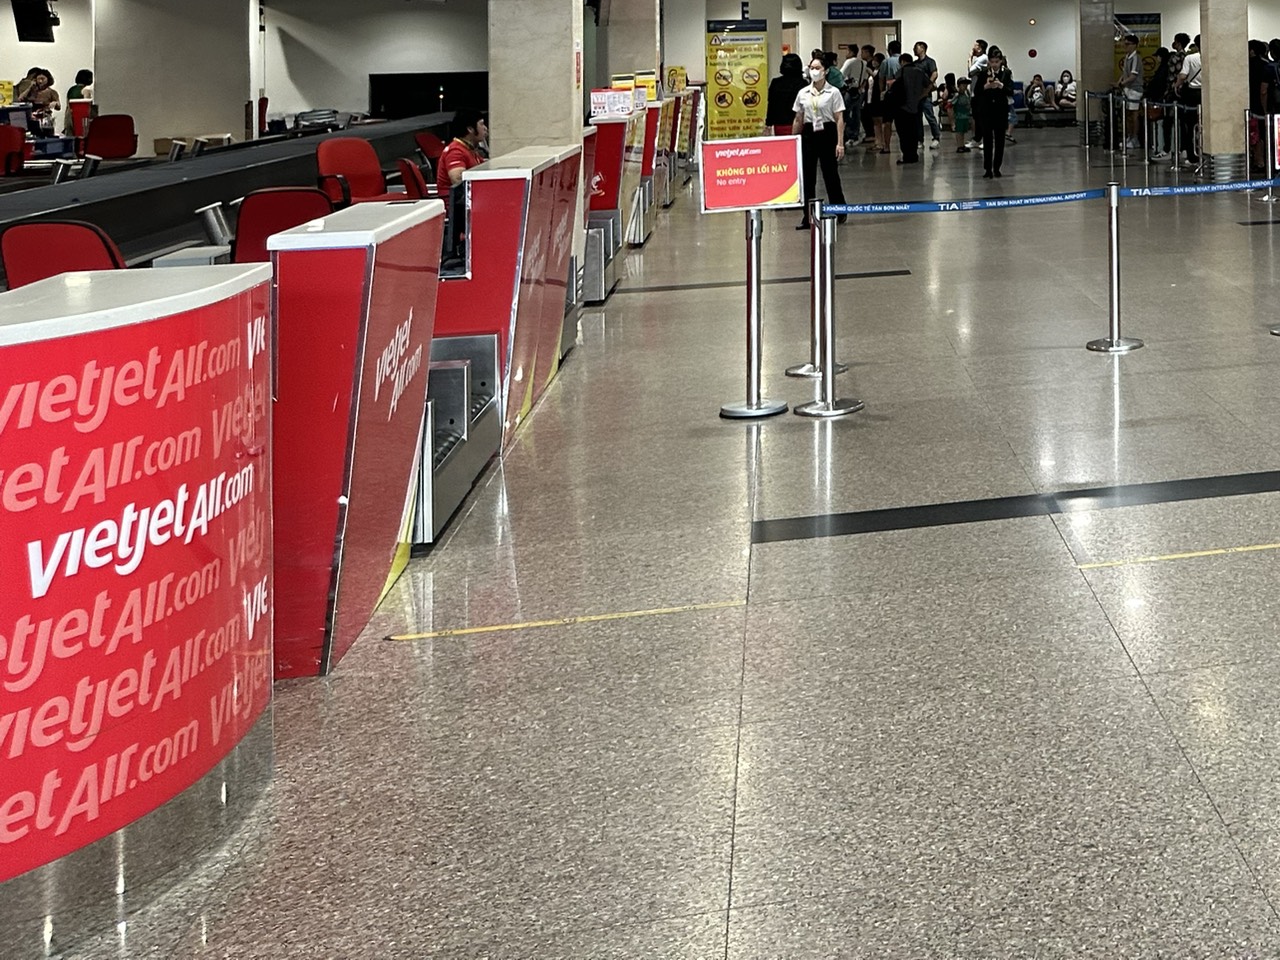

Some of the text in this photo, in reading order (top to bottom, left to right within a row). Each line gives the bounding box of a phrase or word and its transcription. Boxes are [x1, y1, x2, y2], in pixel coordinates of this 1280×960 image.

[716, 163, 788, 177] KHÔNG ĐI LỐI NÀY
[728, 178, 746, 186] entry
[1130, 188, 1152, 196] TIA
[847, 204, 862, 212] QUỐC
[1024, 196, 1063, 204] INTERNATIONAL
